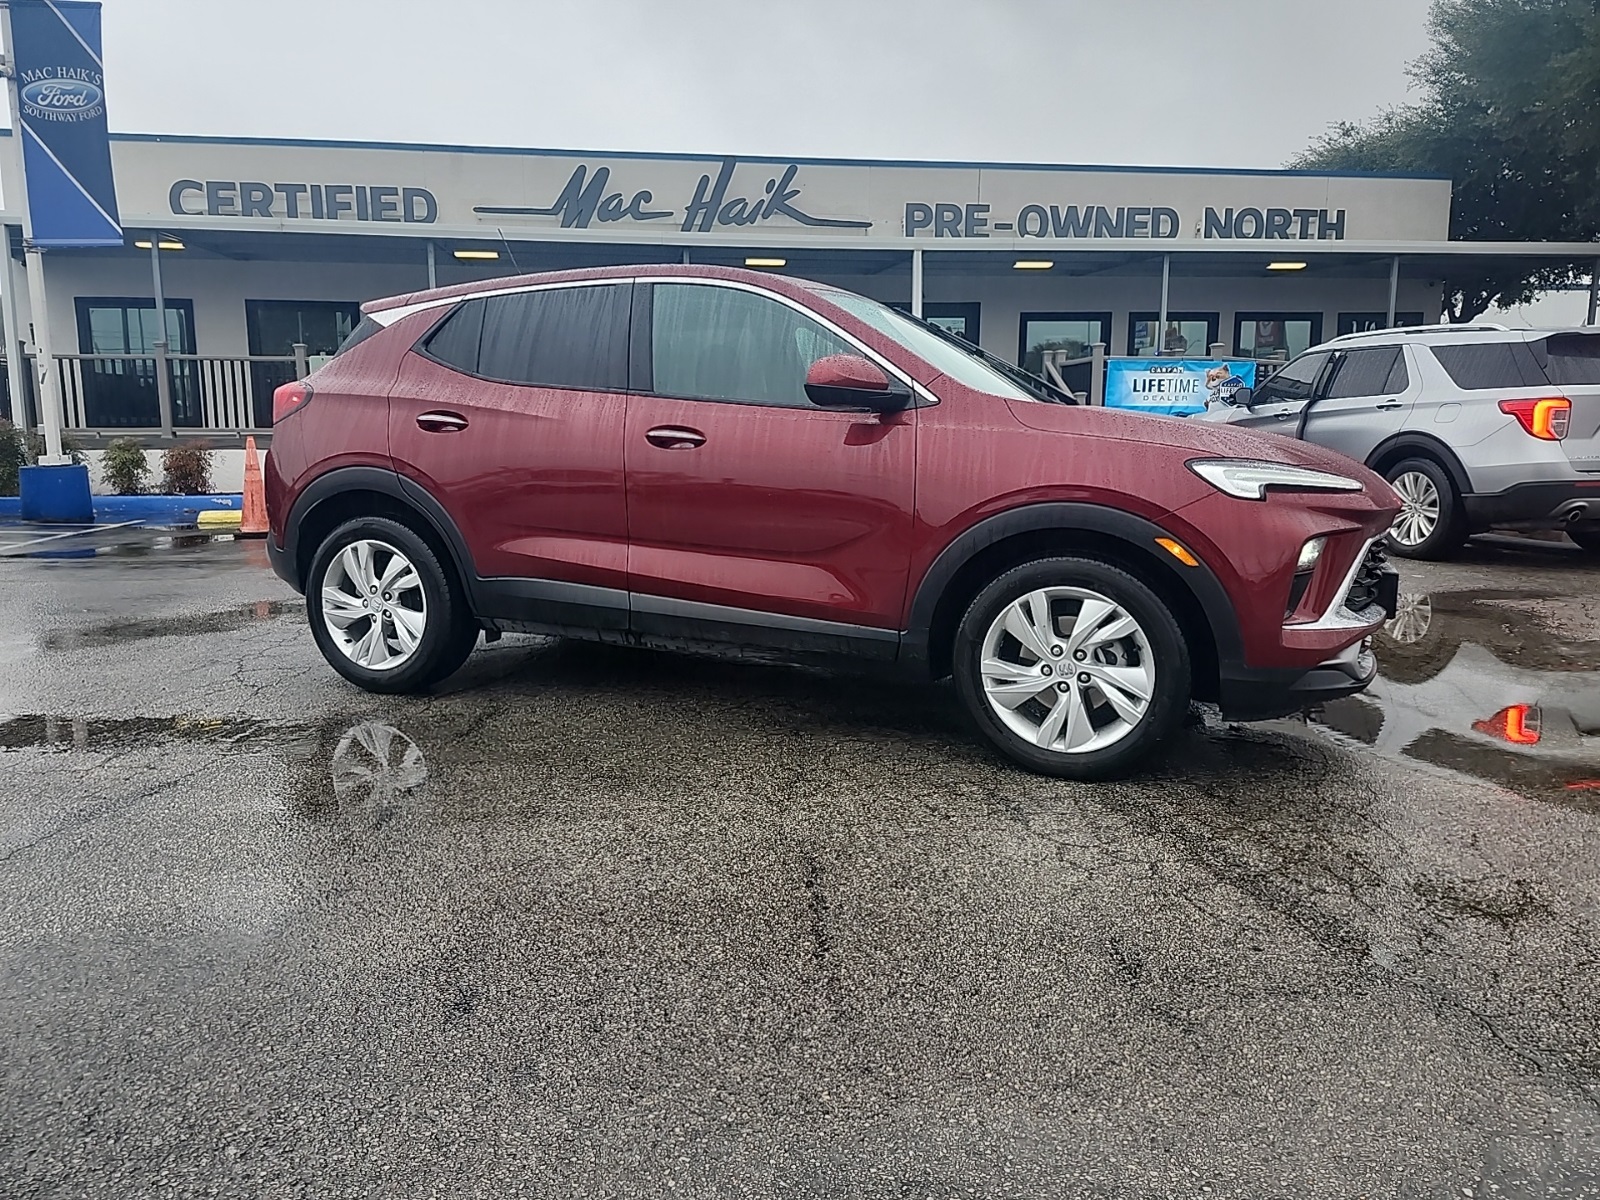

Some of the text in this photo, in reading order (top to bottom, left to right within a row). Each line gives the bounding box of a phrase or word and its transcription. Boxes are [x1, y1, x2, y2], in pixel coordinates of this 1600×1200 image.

[21, 67, 103, 86] MAC HAIK'S
[38, 84, 88, 106] Ford
[23, 105, 103, 122] SOUTHWAY FORD
[169, 179, 438, 224] CERTIFIED
[473, 156, 872, 233] Mac Haik
[904, 202, 1347, 240] PRE-OWNED NORTH
[1150, 366, 1184, 374] CARFAX
[1133, 379, 1199, 393] LIFETIME
